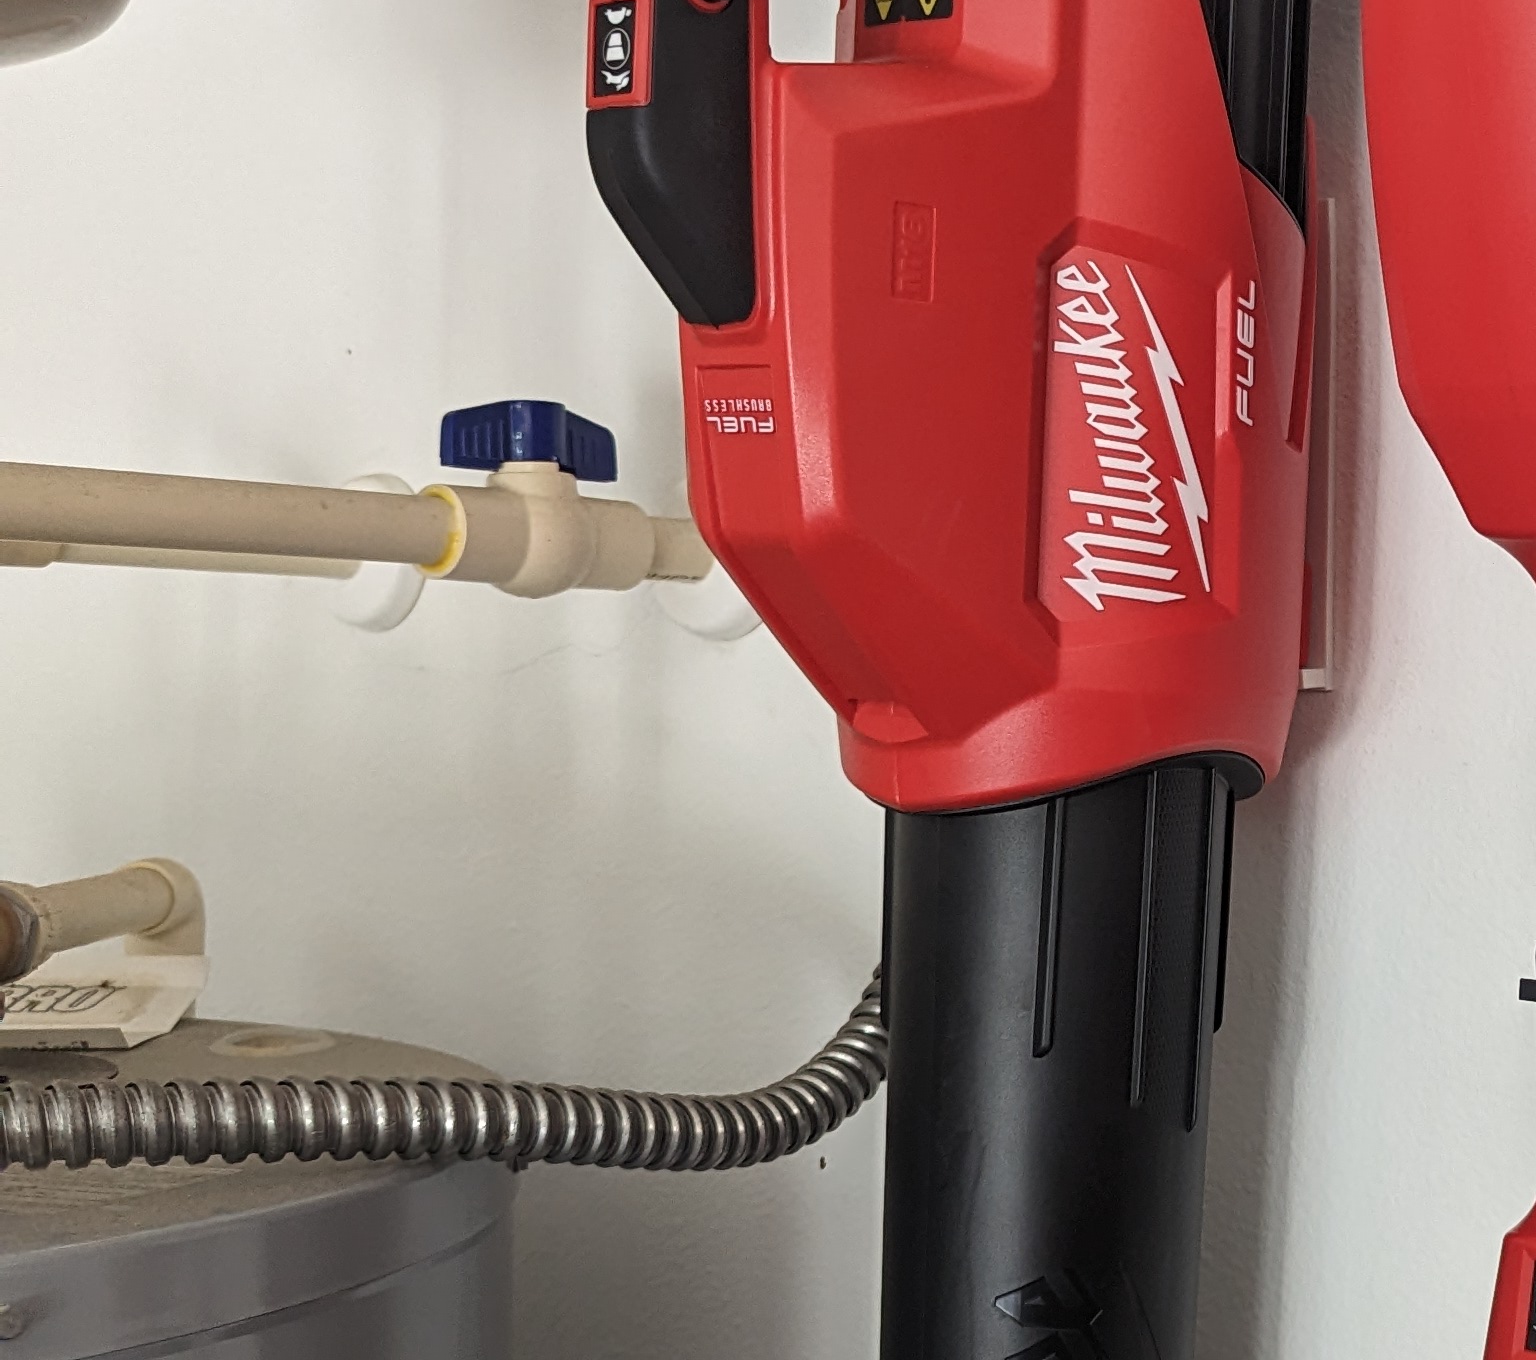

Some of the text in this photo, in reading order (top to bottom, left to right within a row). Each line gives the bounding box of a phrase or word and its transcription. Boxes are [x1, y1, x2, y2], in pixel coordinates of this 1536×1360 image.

[1236, 280, 1257, 426] FUEL
[704, 398, 772, 412] BRUSHLESS
[706, 416, 774, 433] FUEL
[1053, 260, 1187, 612] Milwaukee
